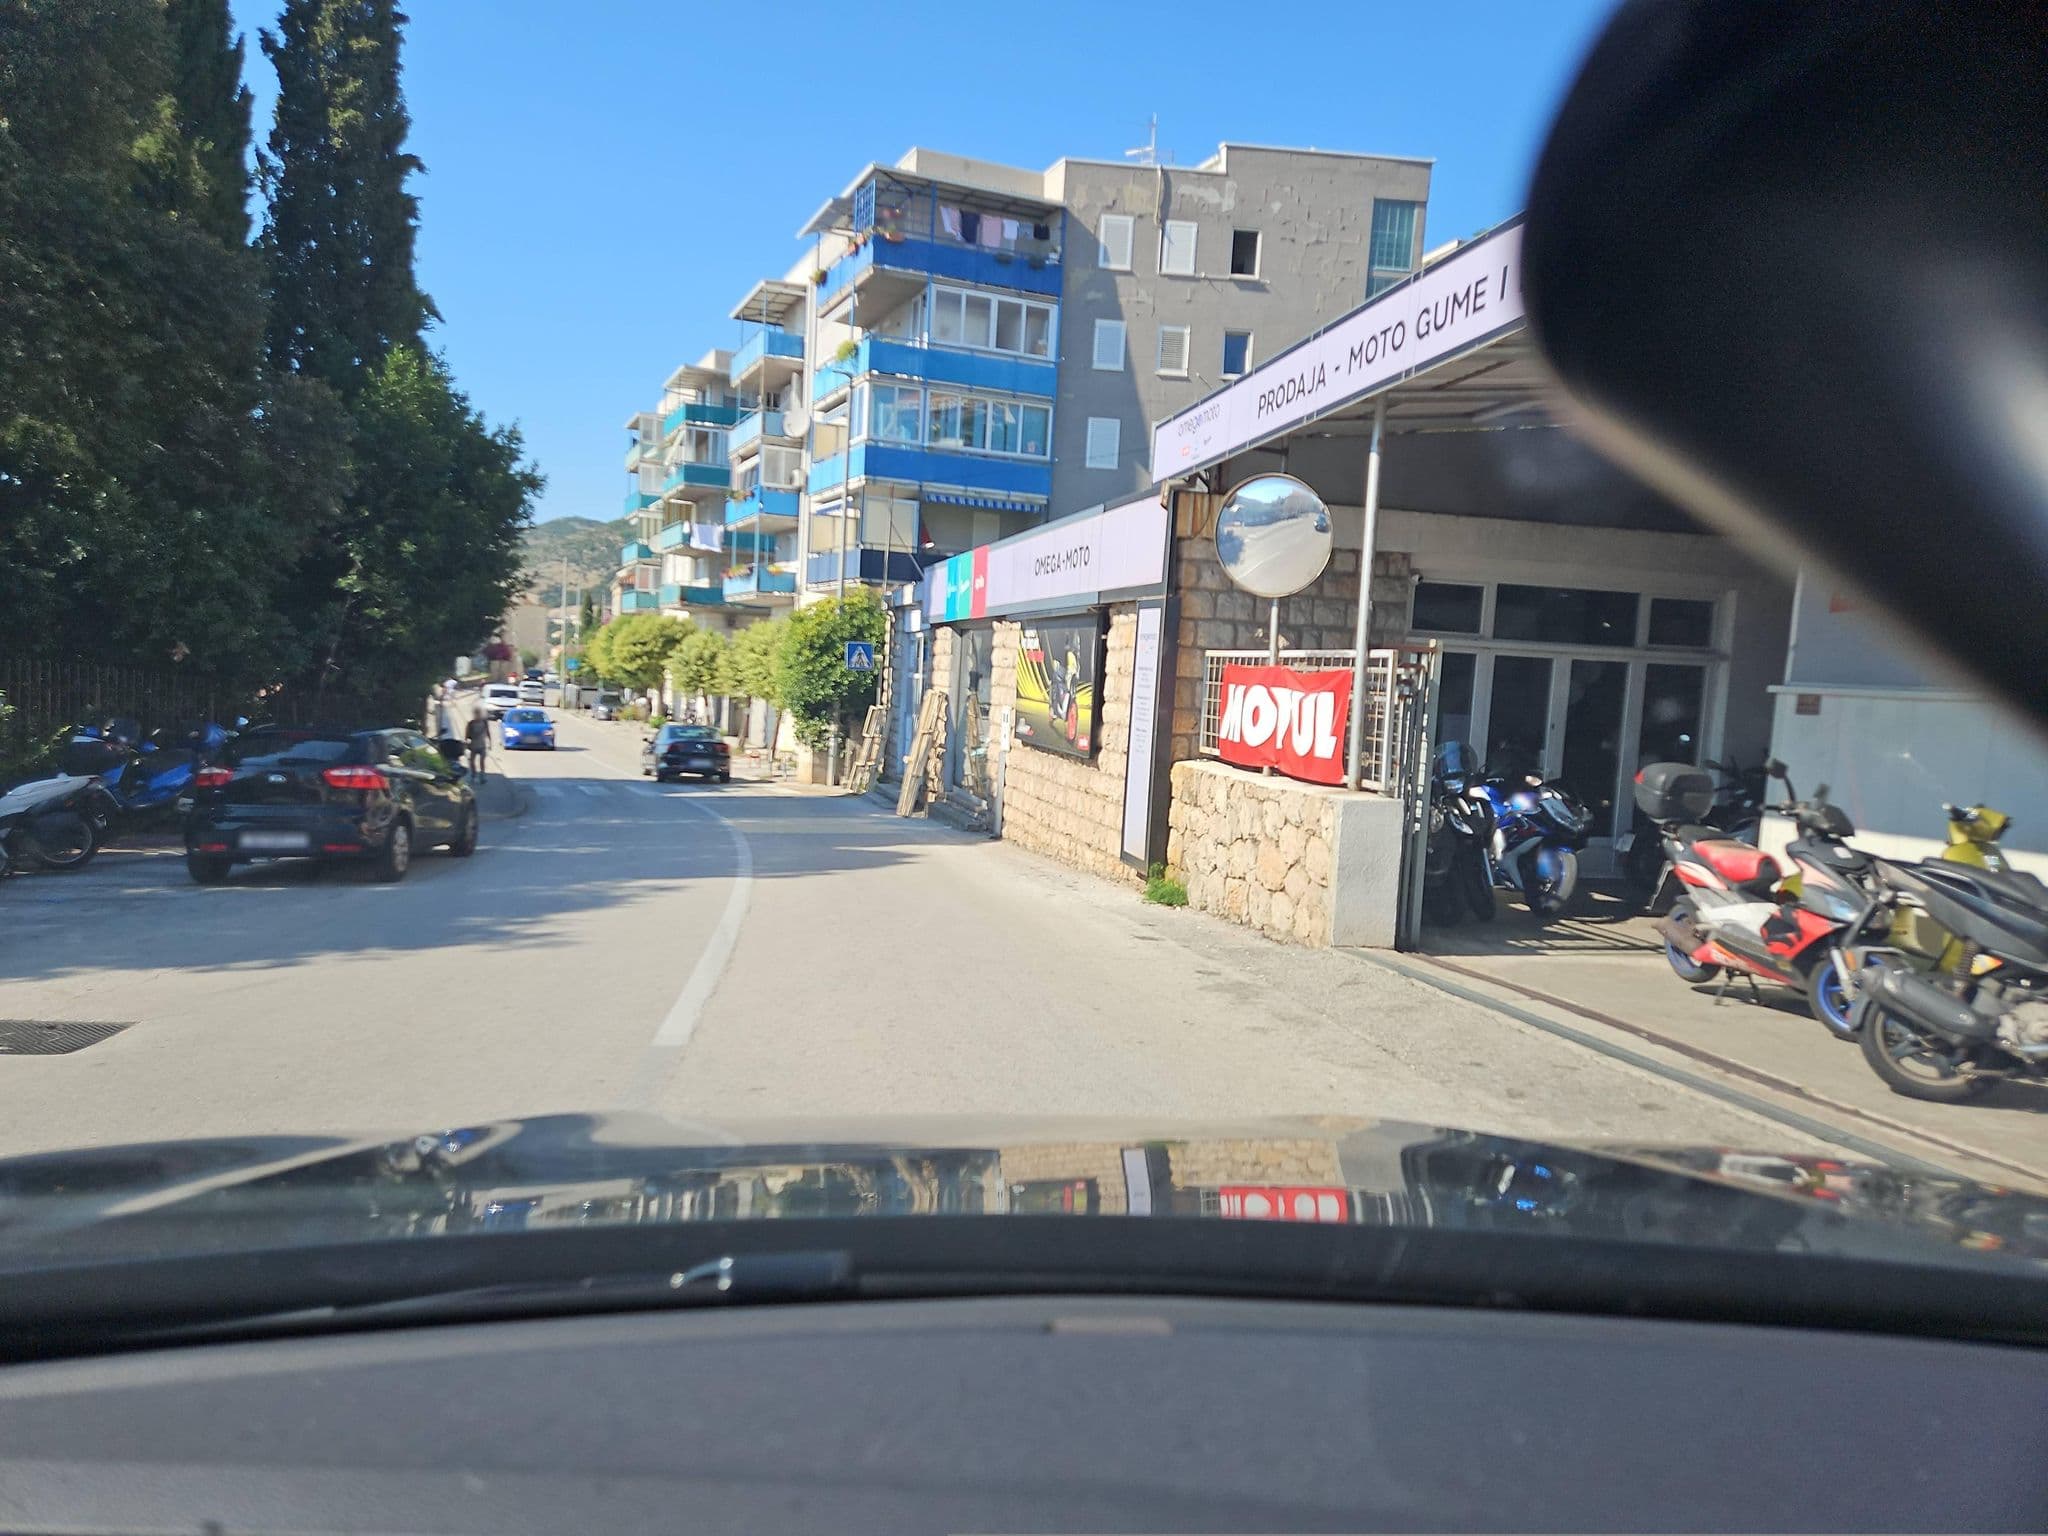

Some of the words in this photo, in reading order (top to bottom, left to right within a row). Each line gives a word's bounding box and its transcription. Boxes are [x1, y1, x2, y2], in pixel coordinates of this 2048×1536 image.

[1257, 361, 1327, 419] PRODAJA
[1348, 319, 1406, 376] MOTO
[1415, 274, 1489, 341] GUME
[1034, 545, 1091, 577] OMEGA-MOTO
[1219, 683, 1338, 760] MOTUL
